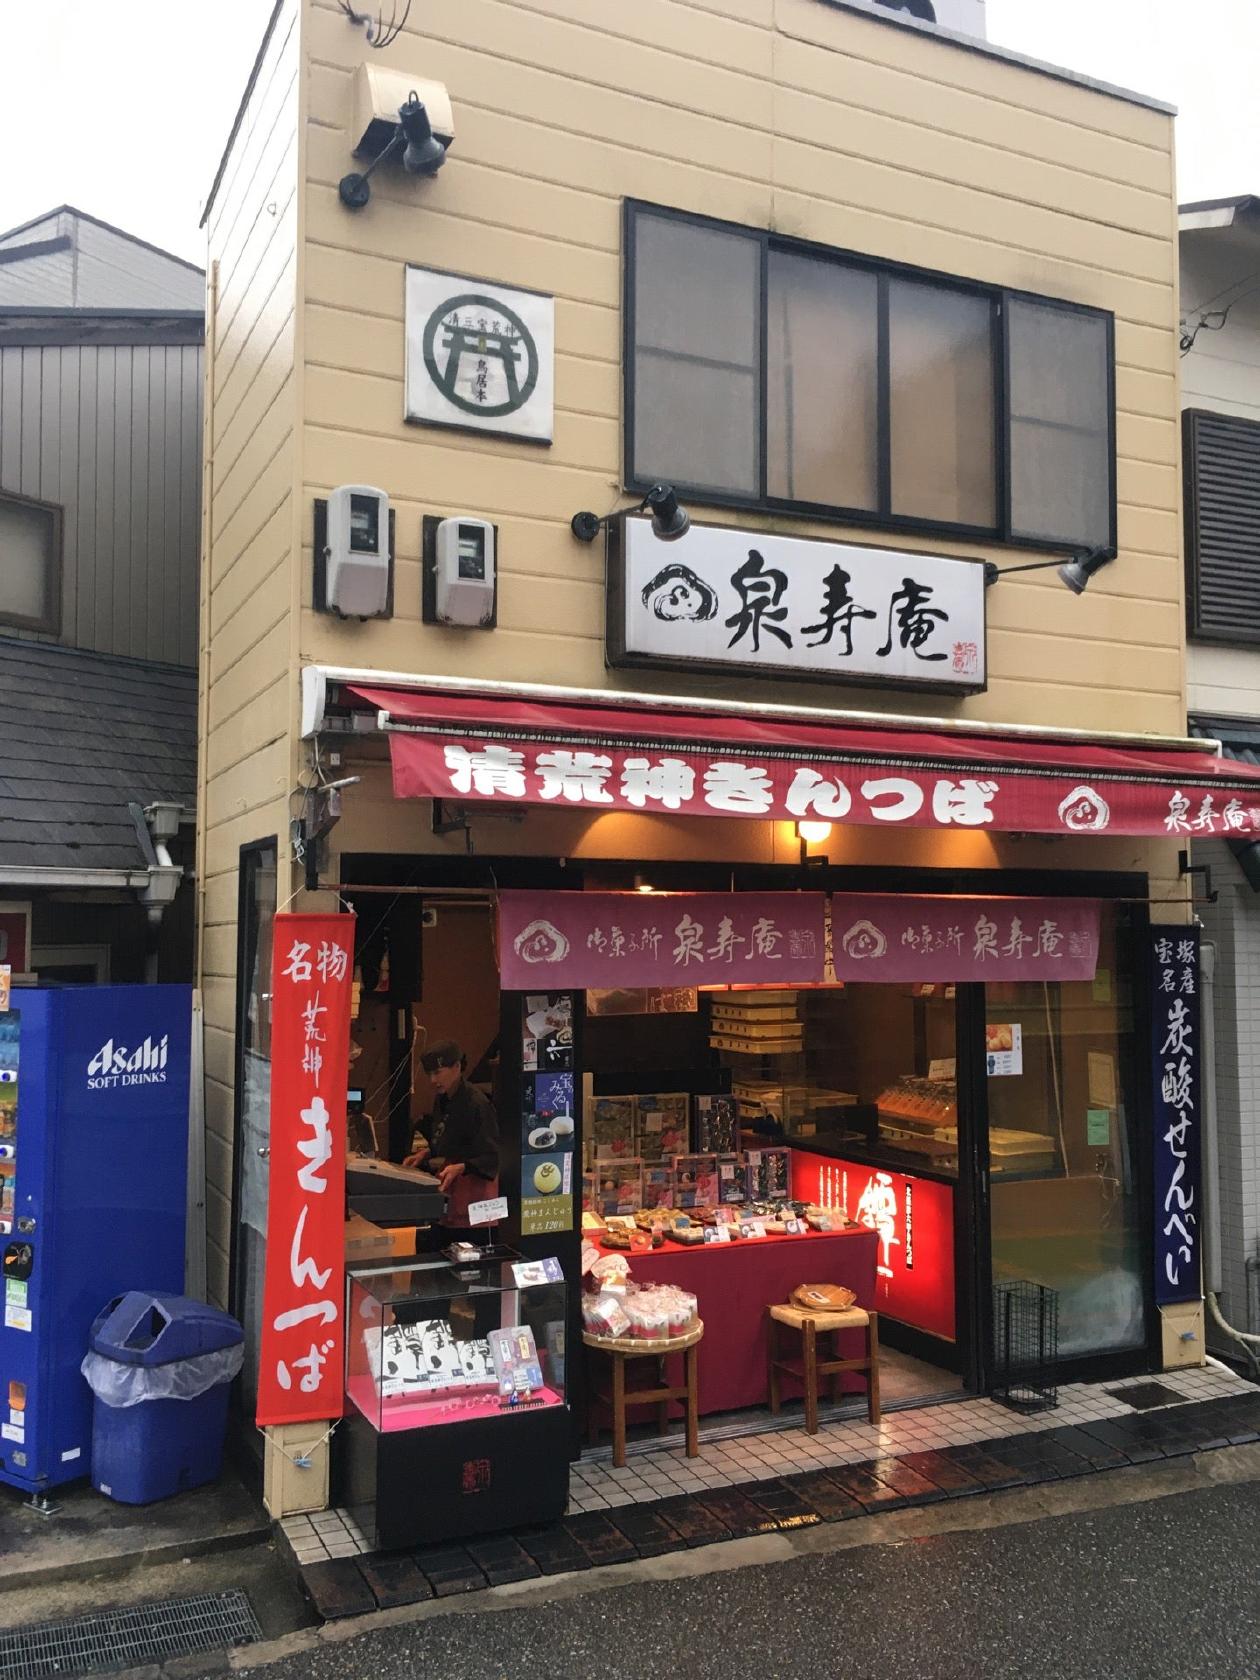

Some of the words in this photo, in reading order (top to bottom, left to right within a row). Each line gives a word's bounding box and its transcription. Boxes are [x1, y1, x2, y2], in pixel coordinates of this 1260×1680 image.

[444, 745, 999, 826] 清荒神きんつば
[281, 939, 348, 984] 名物
[87, 1034, 169, 1076] Asahi
[87, 1075, 119, 1090] SOFT
[122, 1071, 167, 1087] DRINKS
